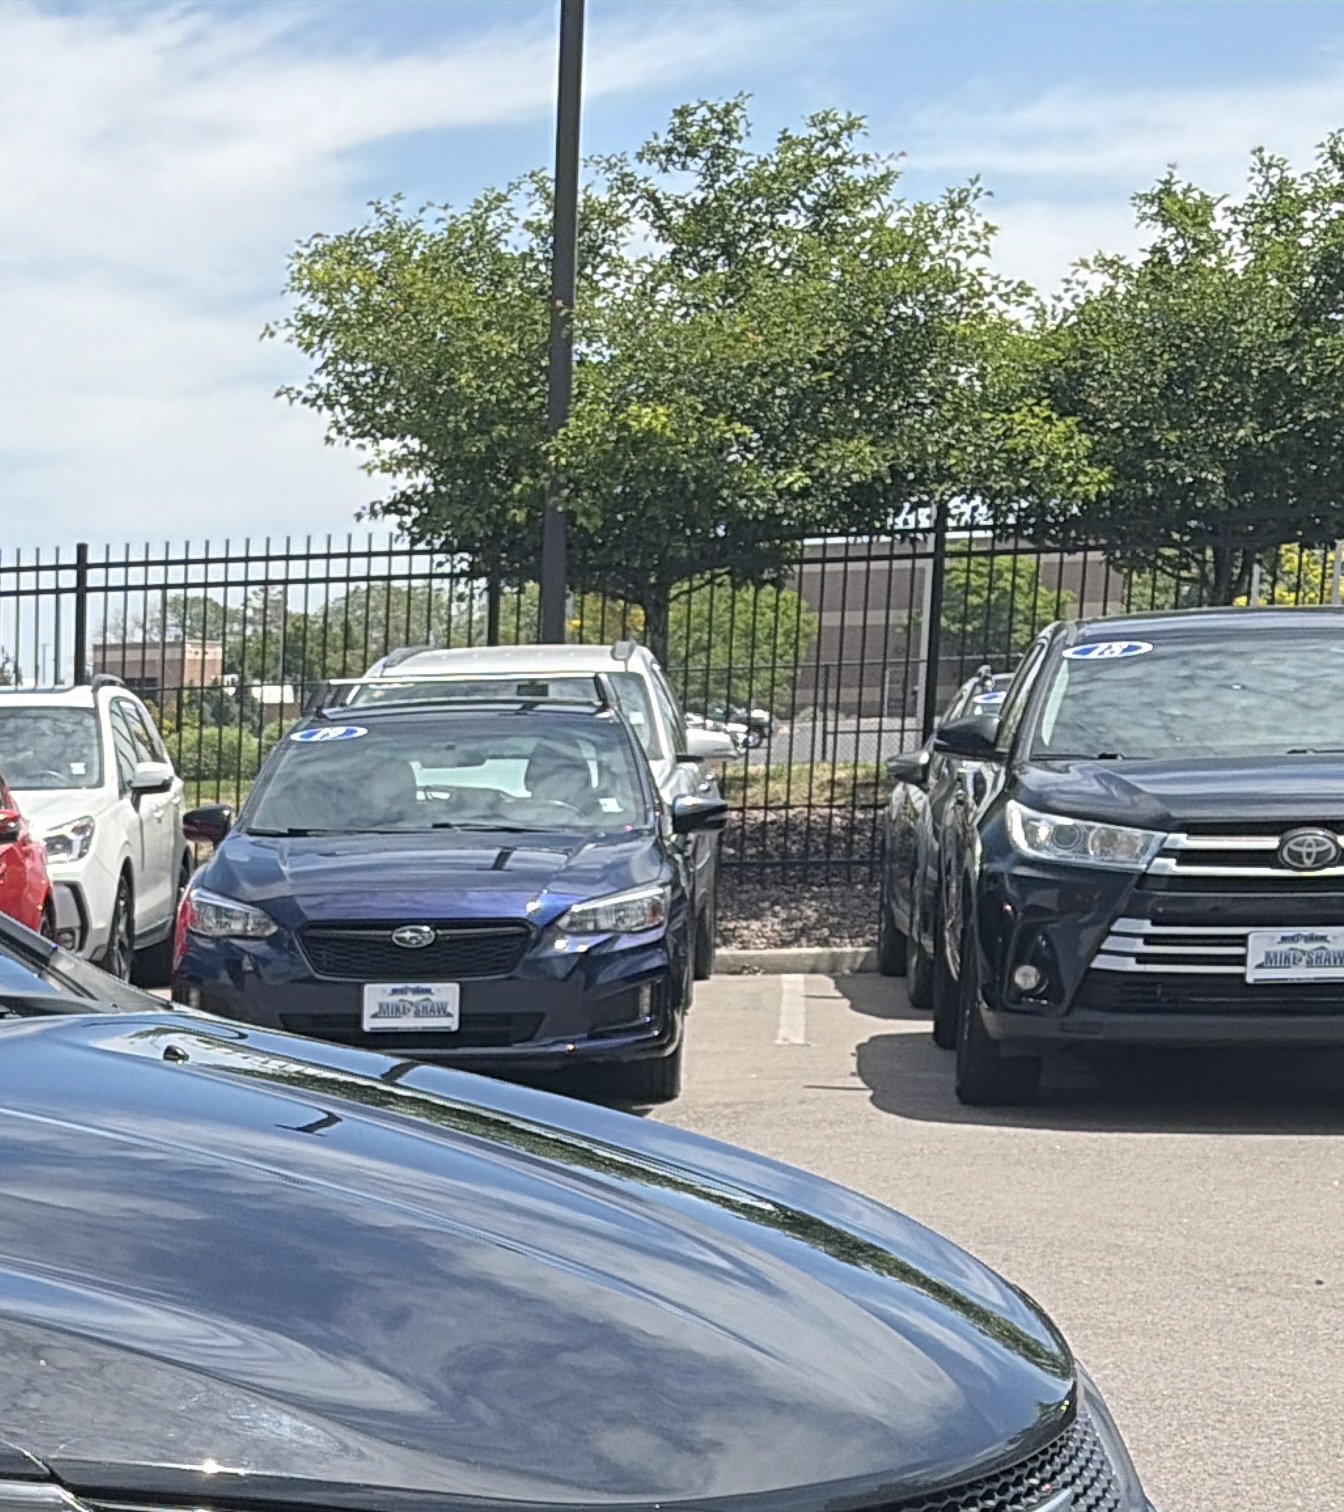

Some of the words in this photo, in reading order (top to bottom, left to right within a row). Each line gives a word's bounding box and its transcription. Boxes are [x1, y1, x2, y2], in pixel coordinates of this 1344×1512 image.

[1265, 950, 1300, 966] MIKE
[378, 1002, 411, 1017] MIKE
[414, 1001, 448, 1017] SHAW
